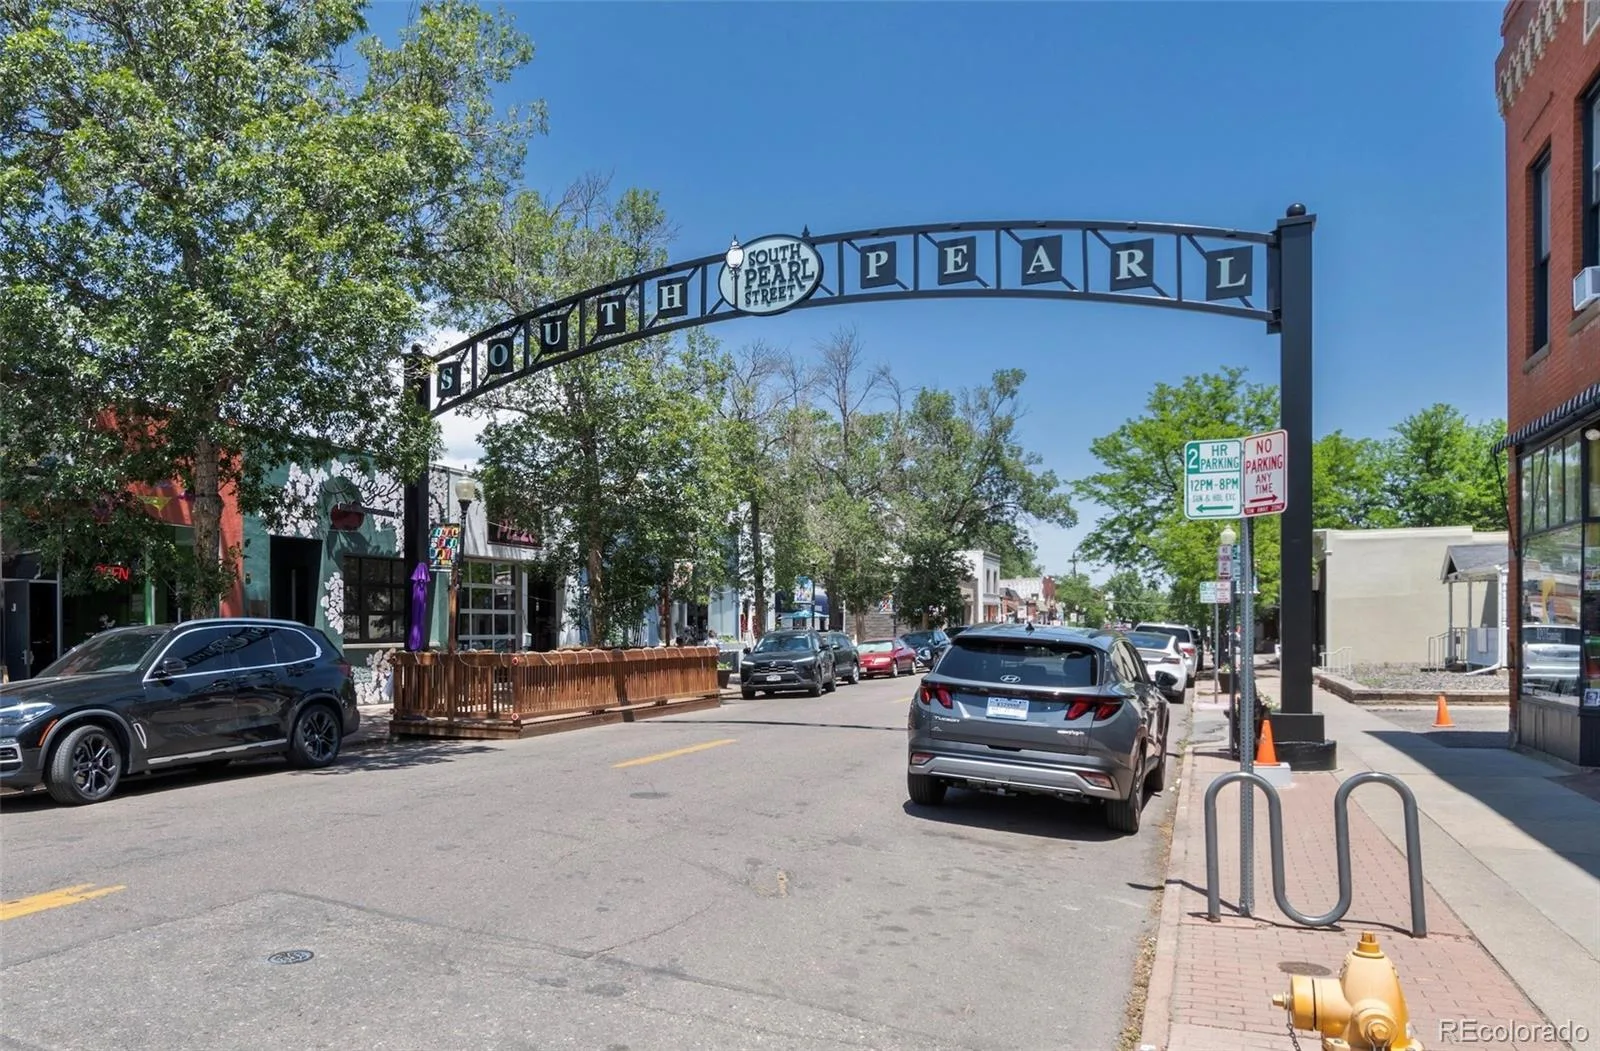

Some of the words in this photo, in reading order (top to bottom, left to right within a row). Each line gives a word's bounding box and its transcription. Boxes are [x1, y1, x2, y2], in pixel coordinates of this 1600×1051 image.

[748, 243, 801, 266] SOUTH
[744, 258, 814, 290] PEARL
[744, 285, 797, 305] STREET
[441, 282, 684, 391] SOUTH
[866, 244, 1248, 290] PEARL
[1211, 444, 1228, 457] HR
[1256, 438, 1272, 455] NO
[1188, 448, 1198, 469] 2
[1201, 457, 1239, 471] PARKING
[1245, 454, 1283, 474] PARKING
[1256, 473, 1272, 484] ANY
[1255, 483, 1273, 495] TIME
